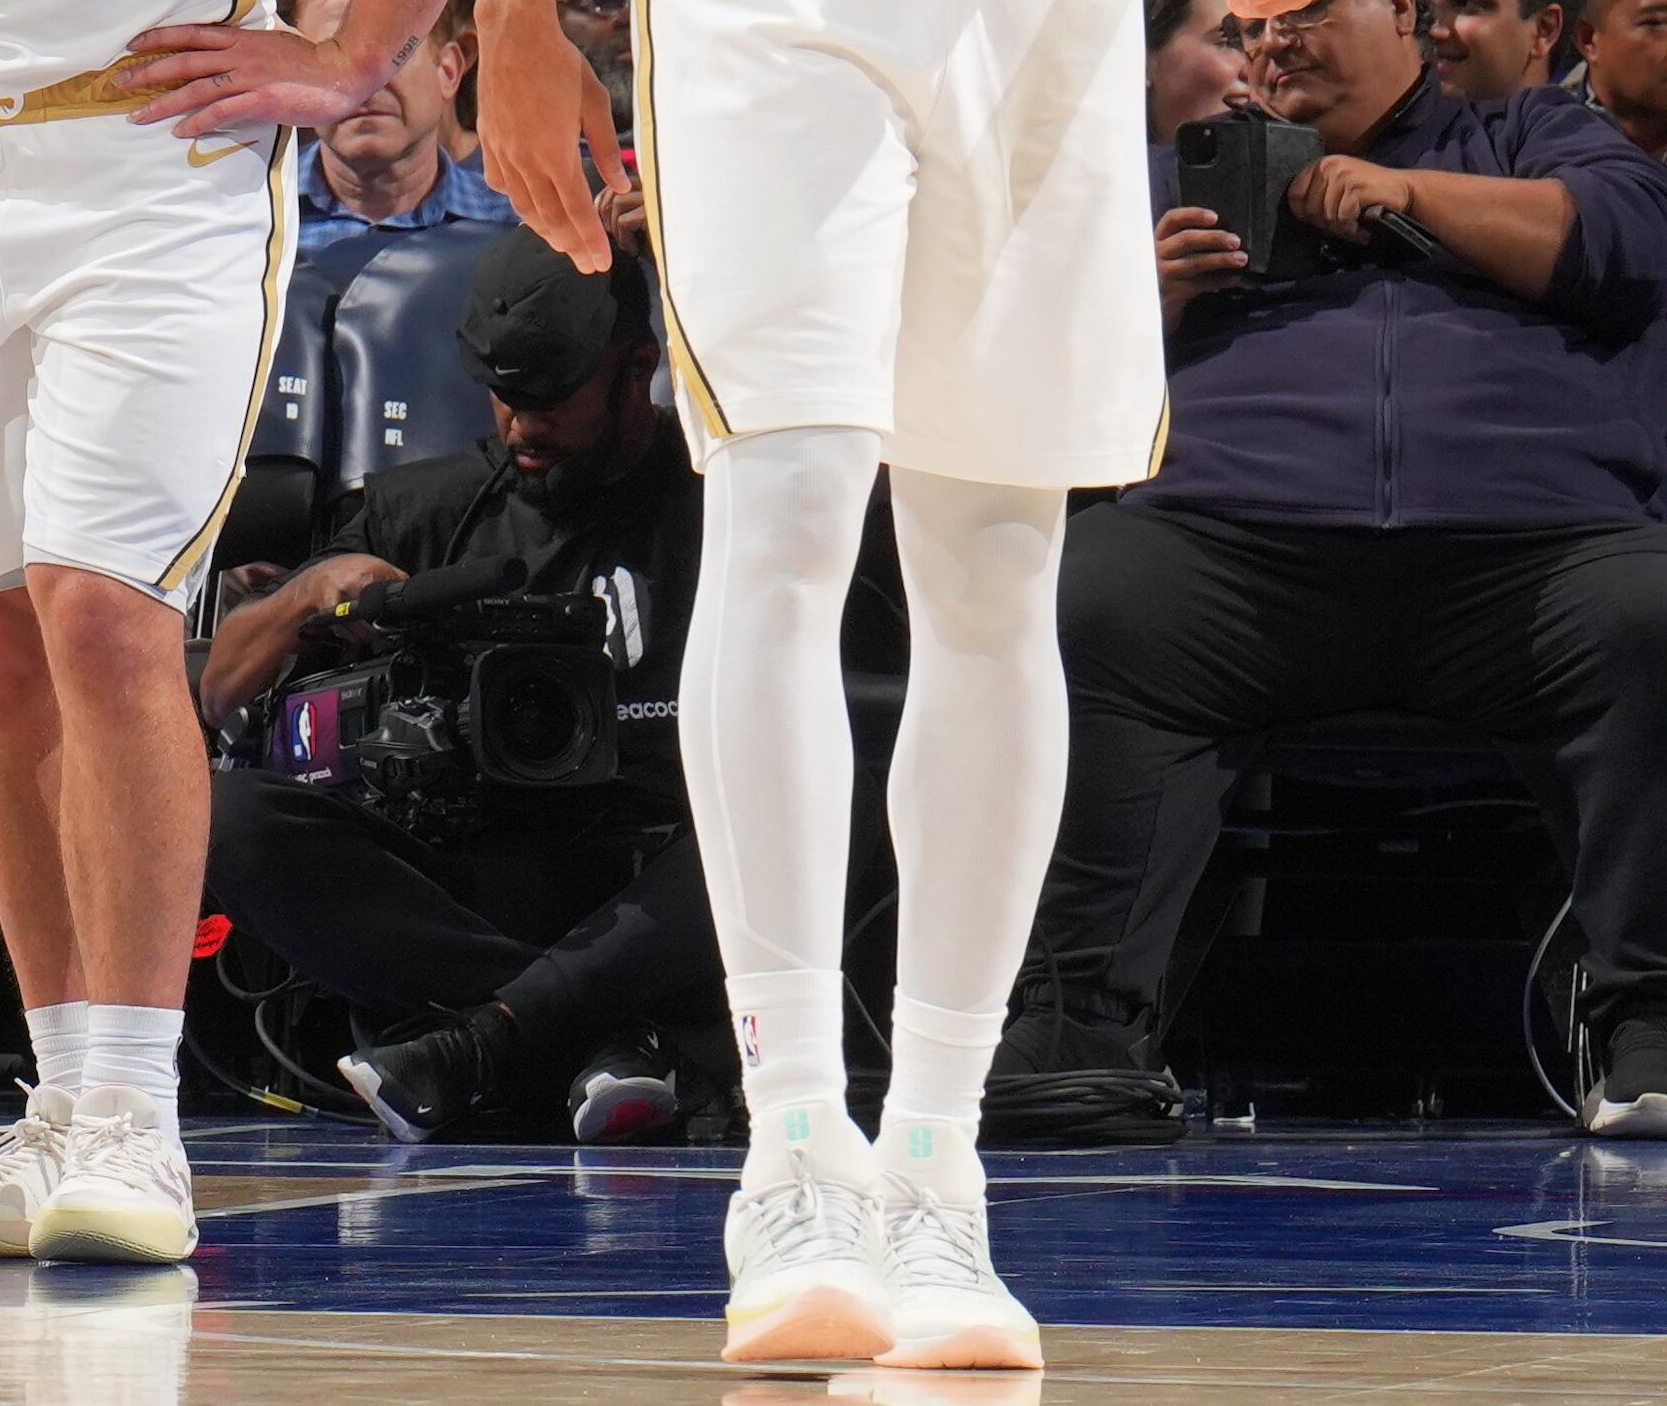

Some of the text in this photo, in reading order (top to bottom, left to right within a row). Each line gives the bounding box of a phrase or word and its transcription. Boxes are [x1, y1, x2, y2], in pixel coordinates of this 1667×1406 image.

[392, 35, 420, 67] 1998
[278, 376, 308, 395] SEAT
[384, 400, 408, 420] SEC
[616, 700, 679, 721] eacoc
